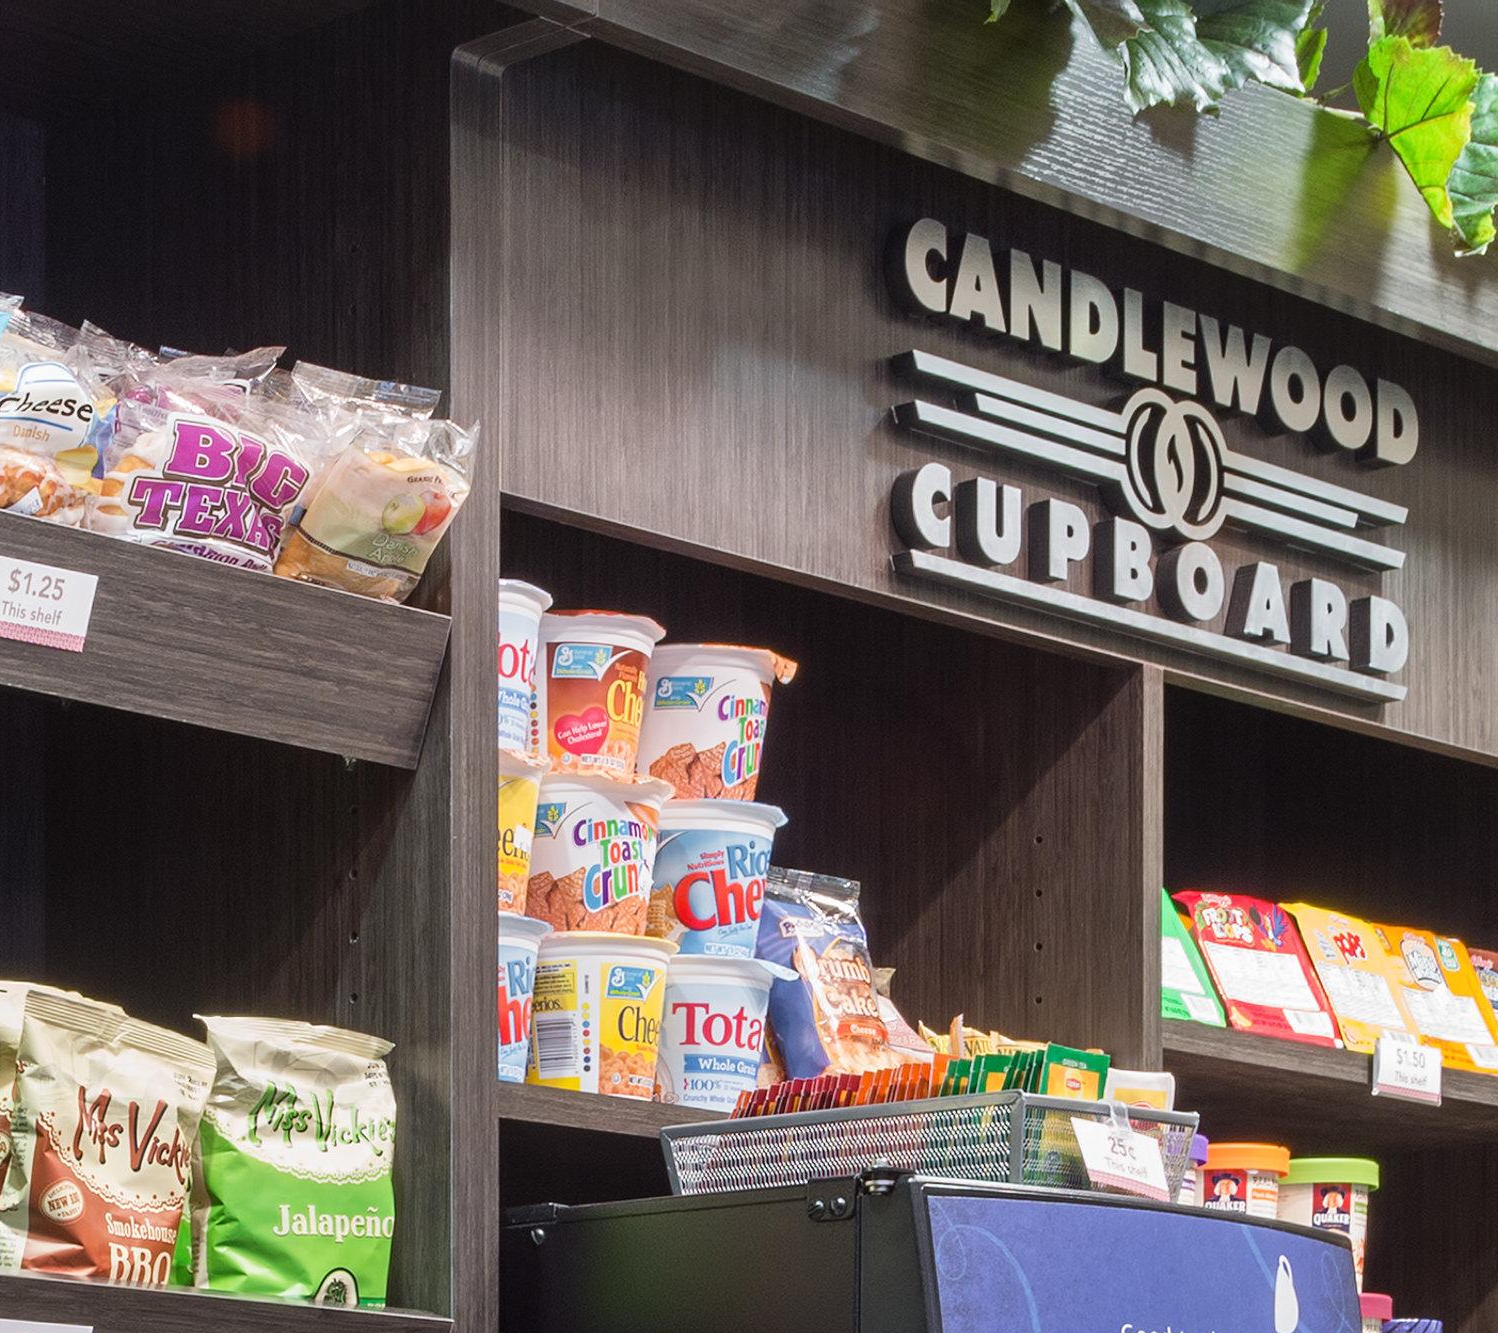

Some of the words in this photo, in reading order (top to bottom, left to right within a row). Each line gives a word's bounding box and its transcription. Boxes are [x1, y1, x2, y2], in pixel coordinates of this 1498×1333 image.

[905, 217, 1419, 465] CANDLEWOOD
[167, 420, 309, 508] BIG
[129, 477, 285, 558] TEXAS
[7, 568, 66, 602] $1.25
[911, 462, 1409, 674] CUPBOARD
[0, 599, 27, 622] This
[29, 603, 64, 627] shelf
[1108, 1137, 1137, 1161] 25¢
[105, 1212, 177, 1246] Smokehouse
[273, 1204, 395, 1243] Jalapeño
[1314, 1214, 1350, 1227] QUAKER
